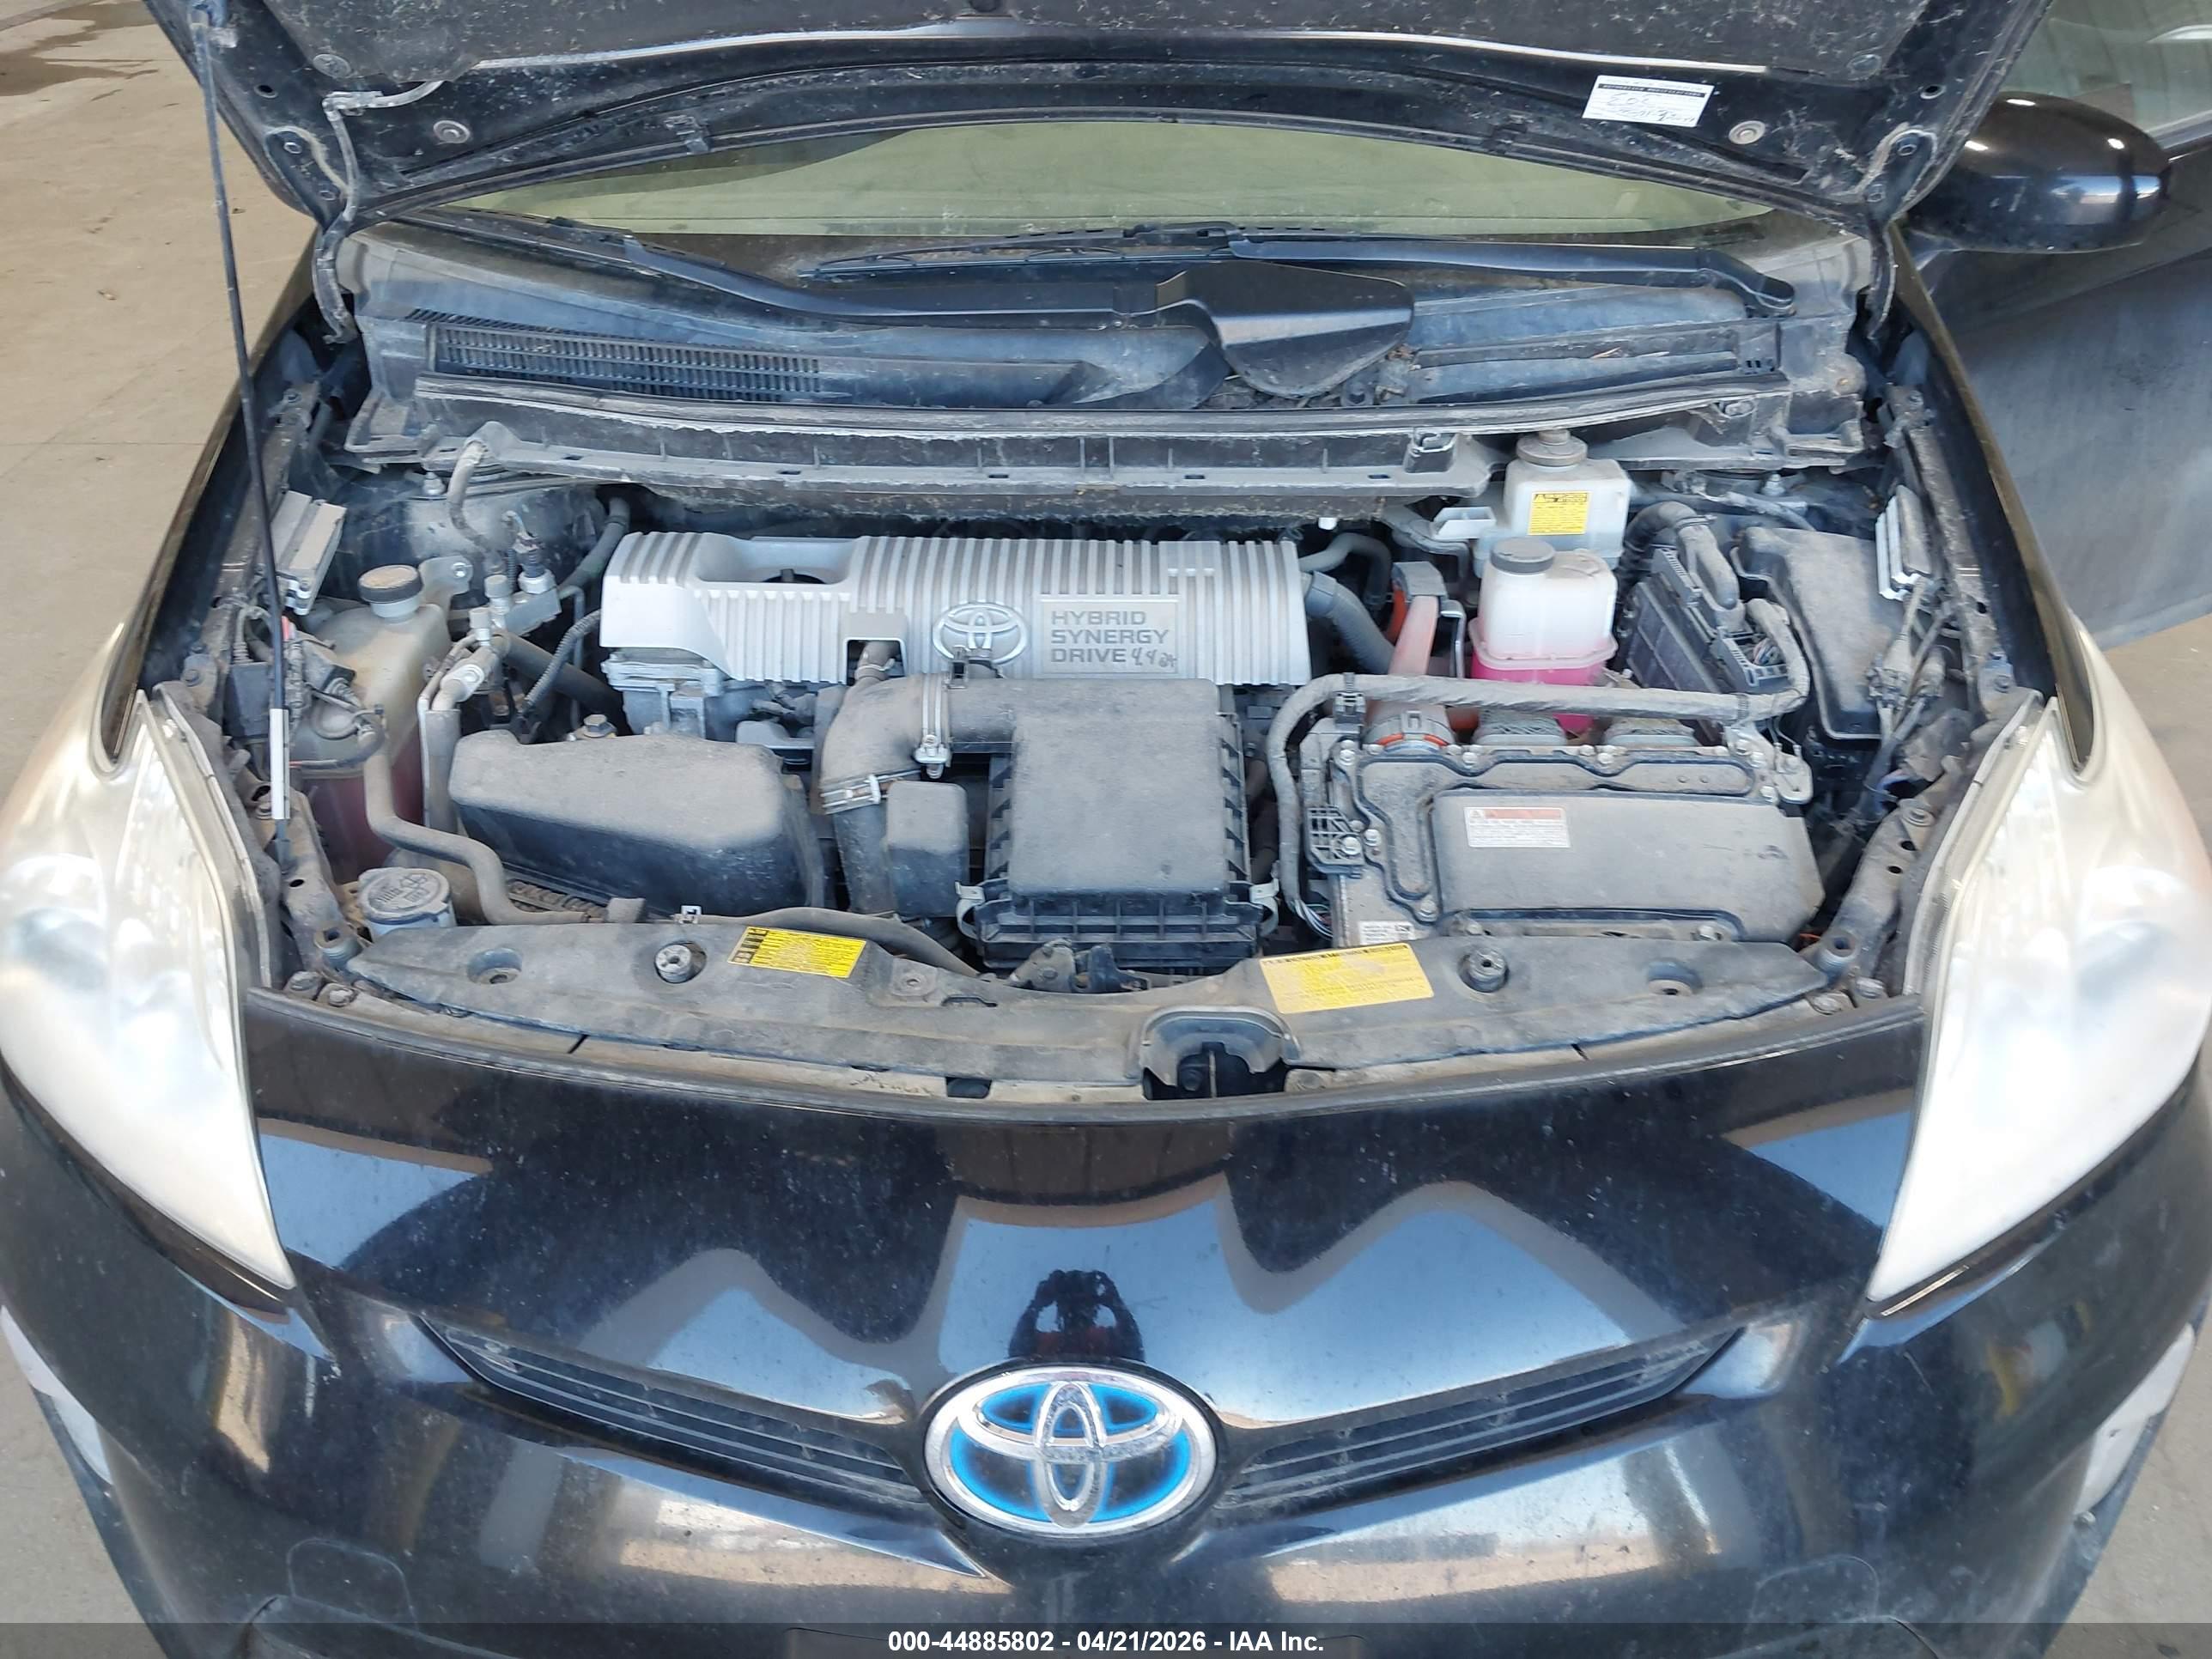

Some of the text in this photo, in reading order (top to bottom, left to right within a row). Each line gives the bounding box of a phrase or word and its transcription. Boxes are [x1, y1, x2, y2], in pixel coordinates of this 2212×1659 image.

[1051, 611, 1146, 625] HYBRID
[1051, 629, 1169, 644] SYNERGY
[1051, 648, 1127, 663] DRIVE
